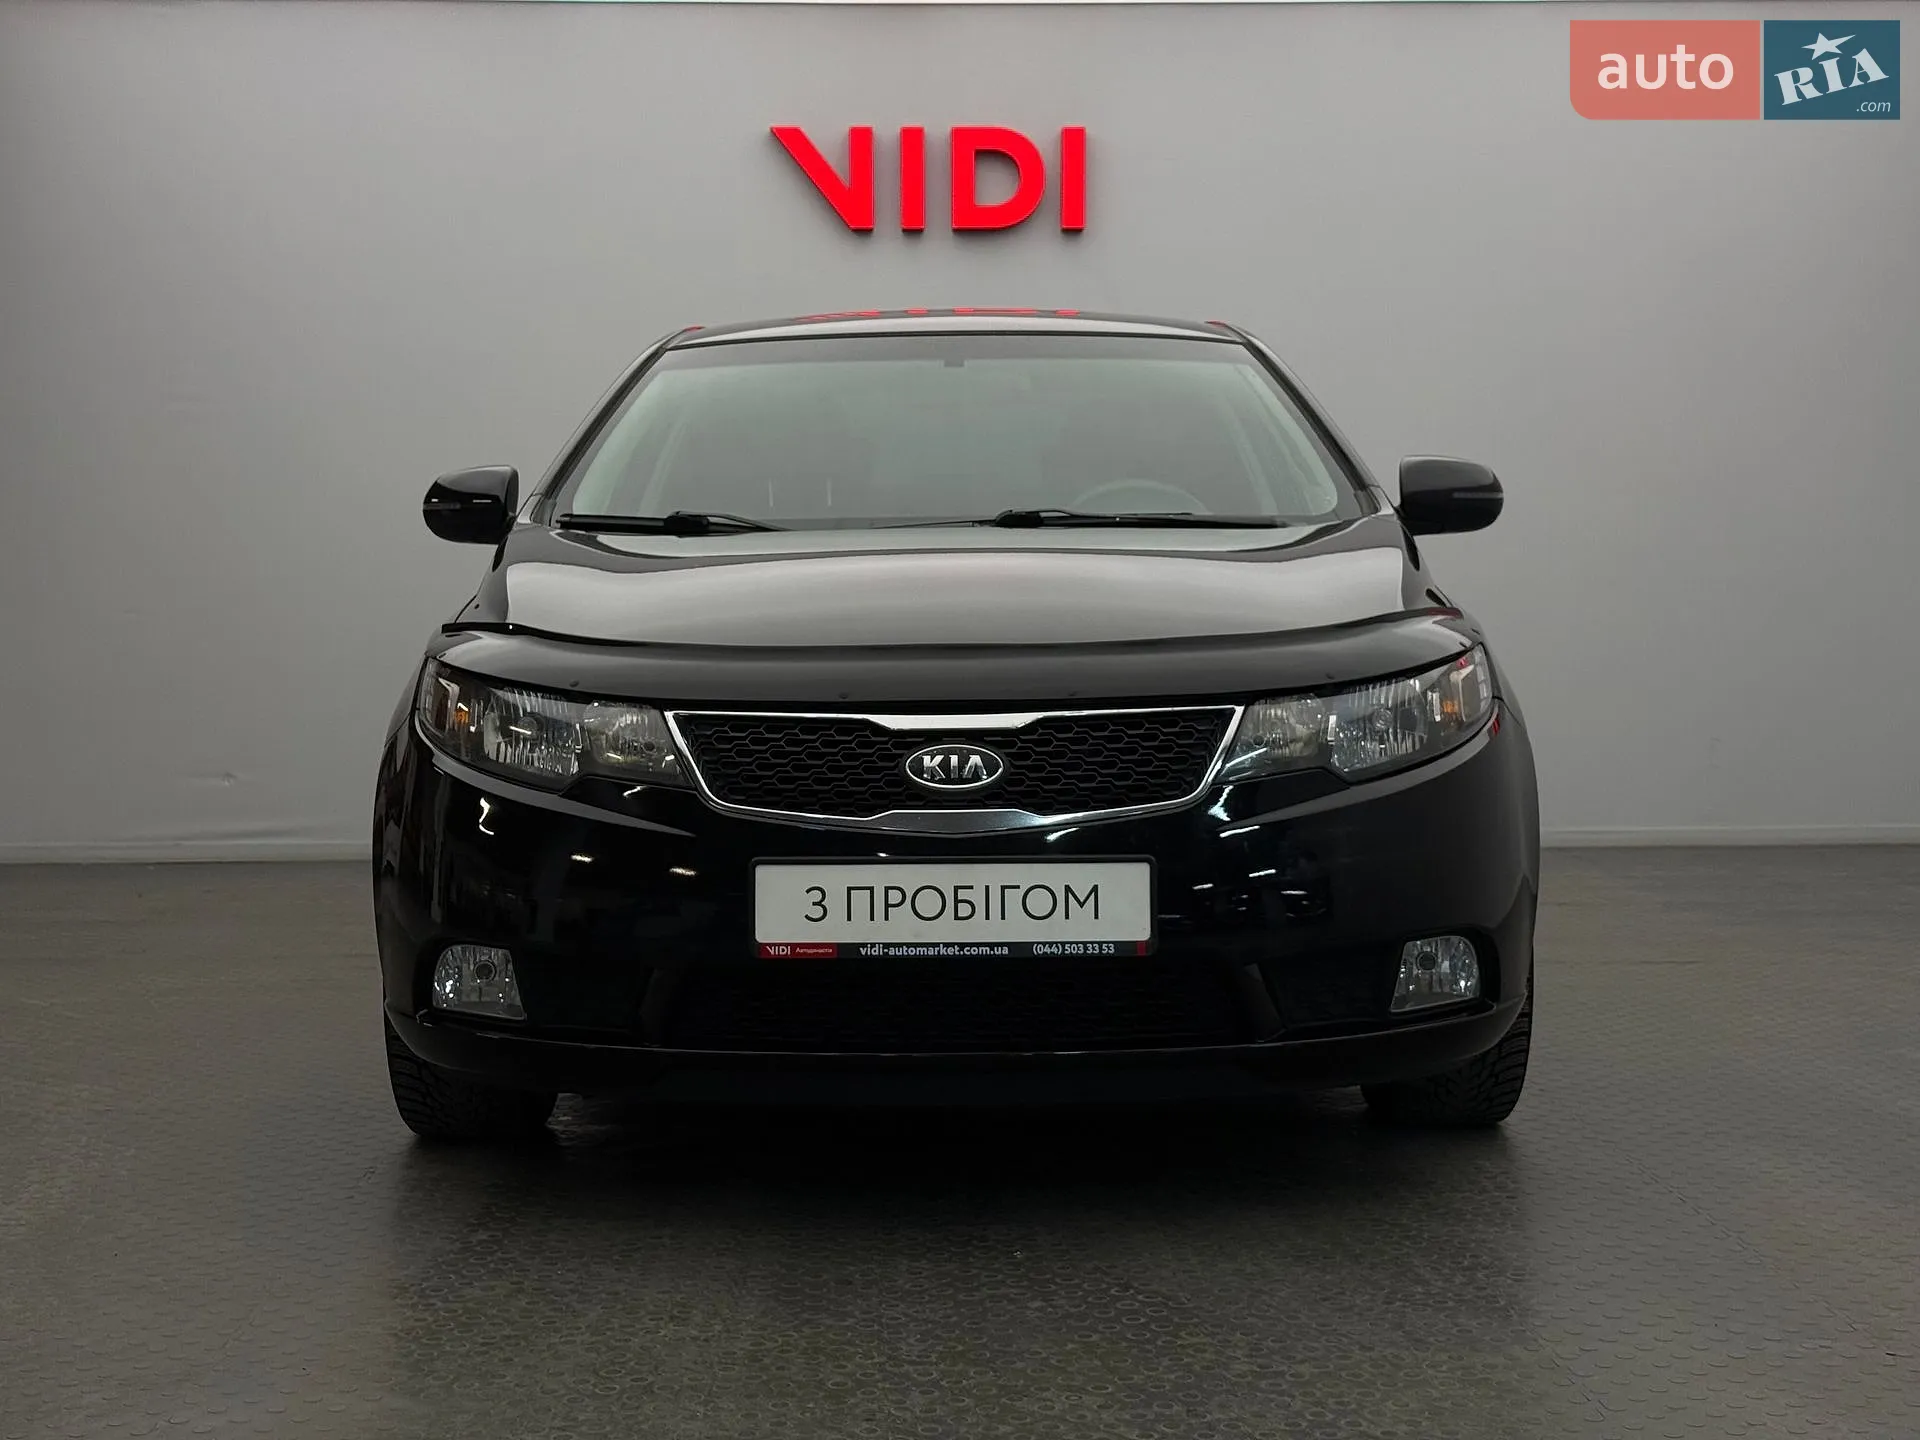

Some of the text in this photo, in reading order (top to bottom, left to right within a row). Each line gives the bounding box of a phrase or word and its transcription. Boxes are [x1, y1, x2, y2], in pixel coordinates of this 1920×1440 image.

[770, 126, 1086, 230] VIDI
[922, 754, 987, 780] KIA
[804, 884, 1099, 922] З ПРОБІГОМ
[766, 946, 790, 955] VIDI
[860, 944, 1008, 955] vidi-automarket.com.ua
[1032, 943, 1114, 955] (044) 503 33 53
